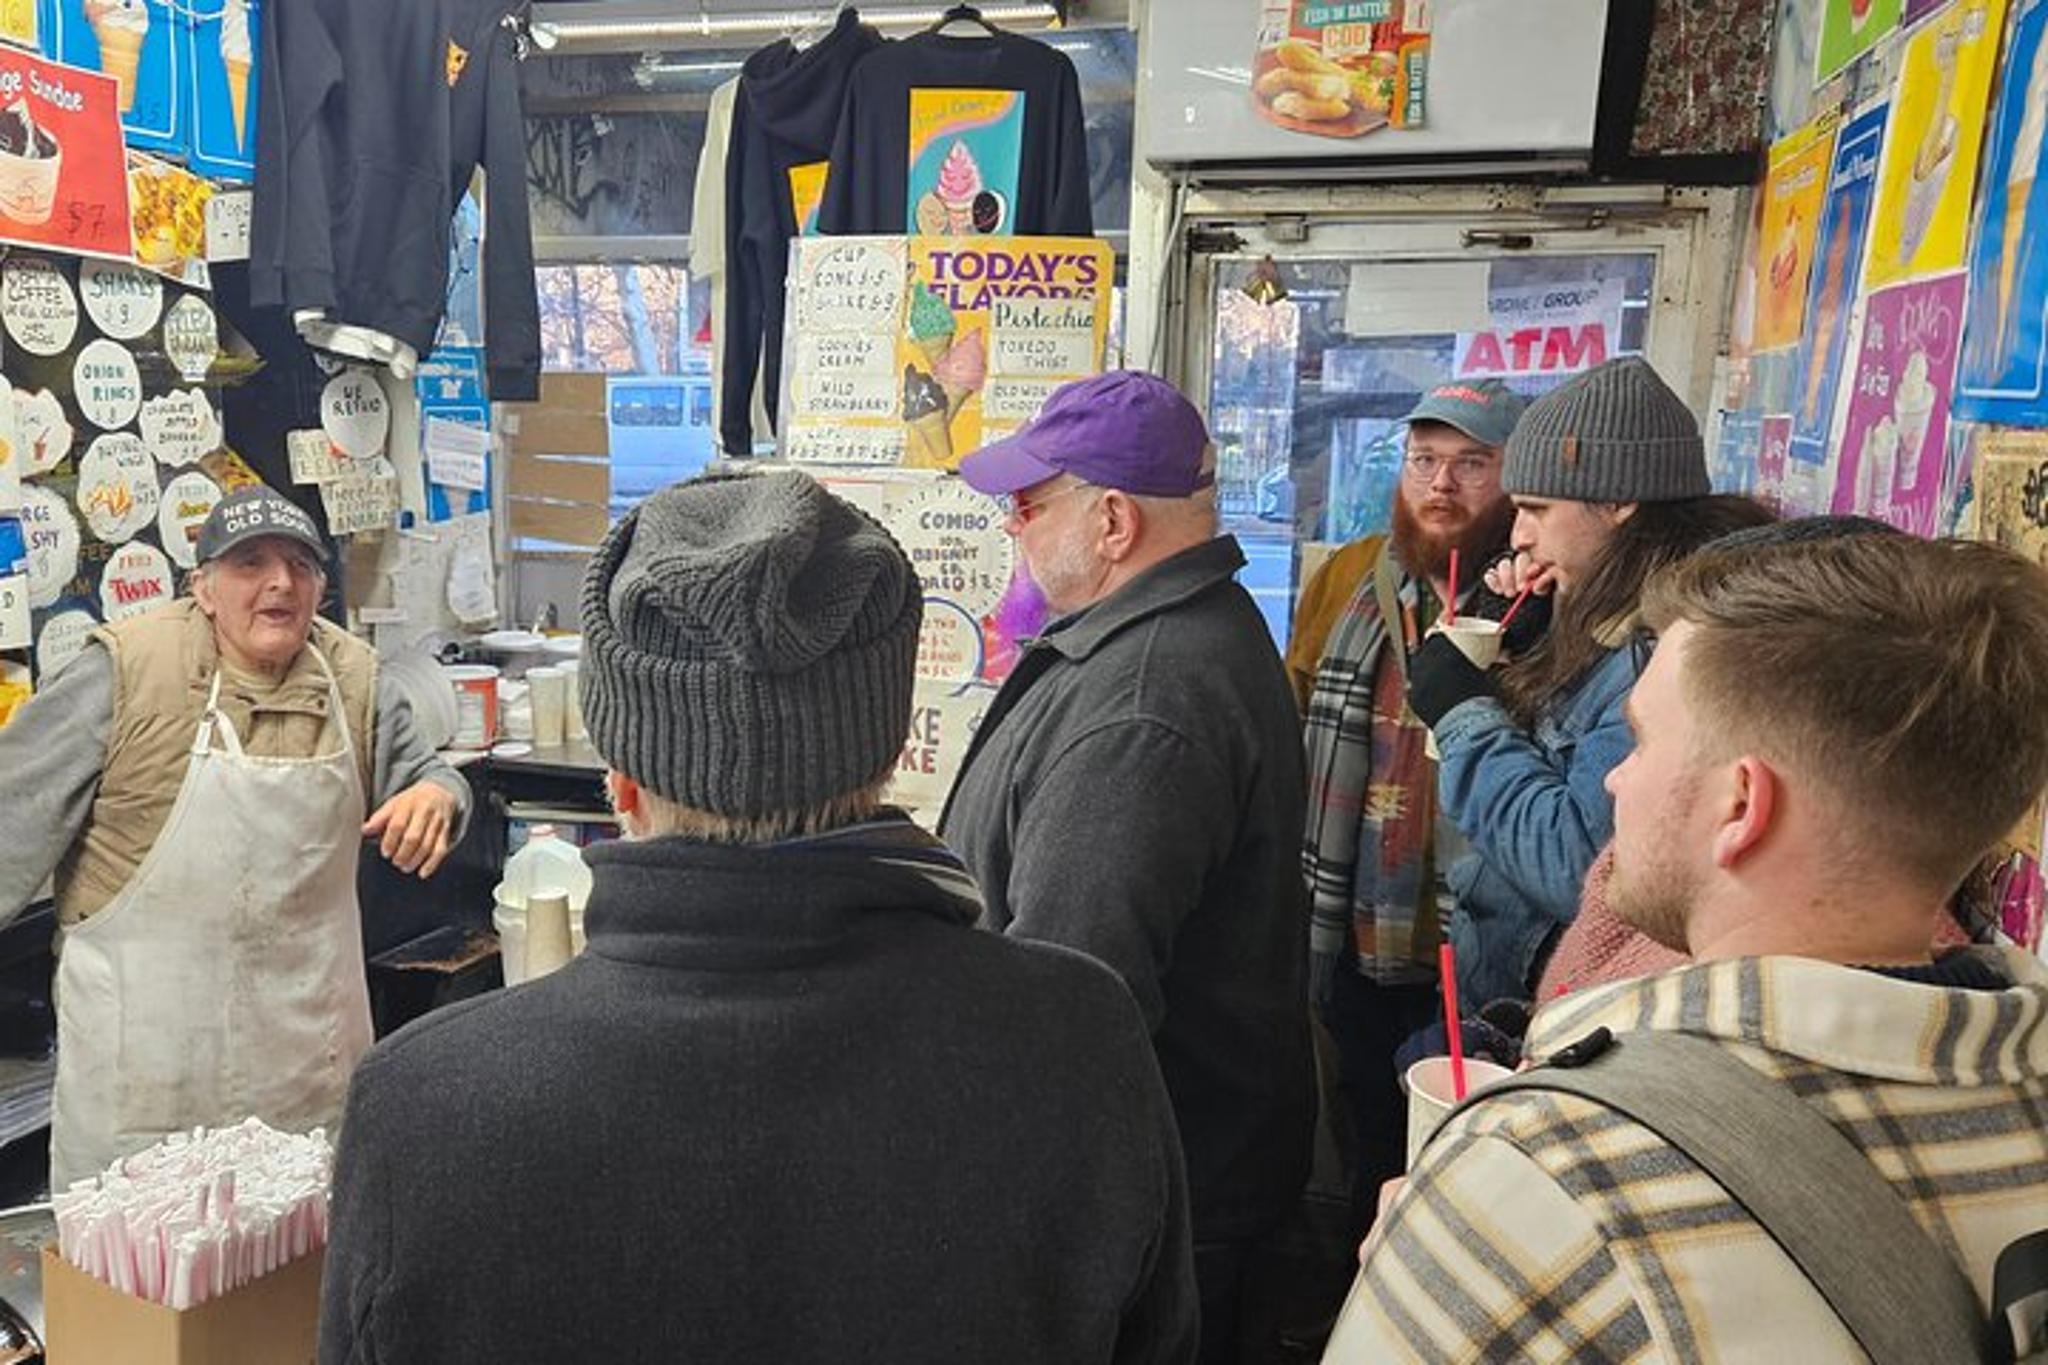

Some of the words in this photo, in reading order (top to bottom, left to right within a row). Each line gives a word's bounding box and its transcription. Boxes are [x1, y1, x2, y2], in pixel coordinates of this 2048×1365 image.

[29, 69, 84, 112] Sundae
[928, 251, 1099, 284] TODAY'S
[1460, 322, 1606, 372] ATM
[223, 500, 262, 519] NEW
[226, 512, 263, 533] OLD
[920, 511, 990, 531] COMBO
